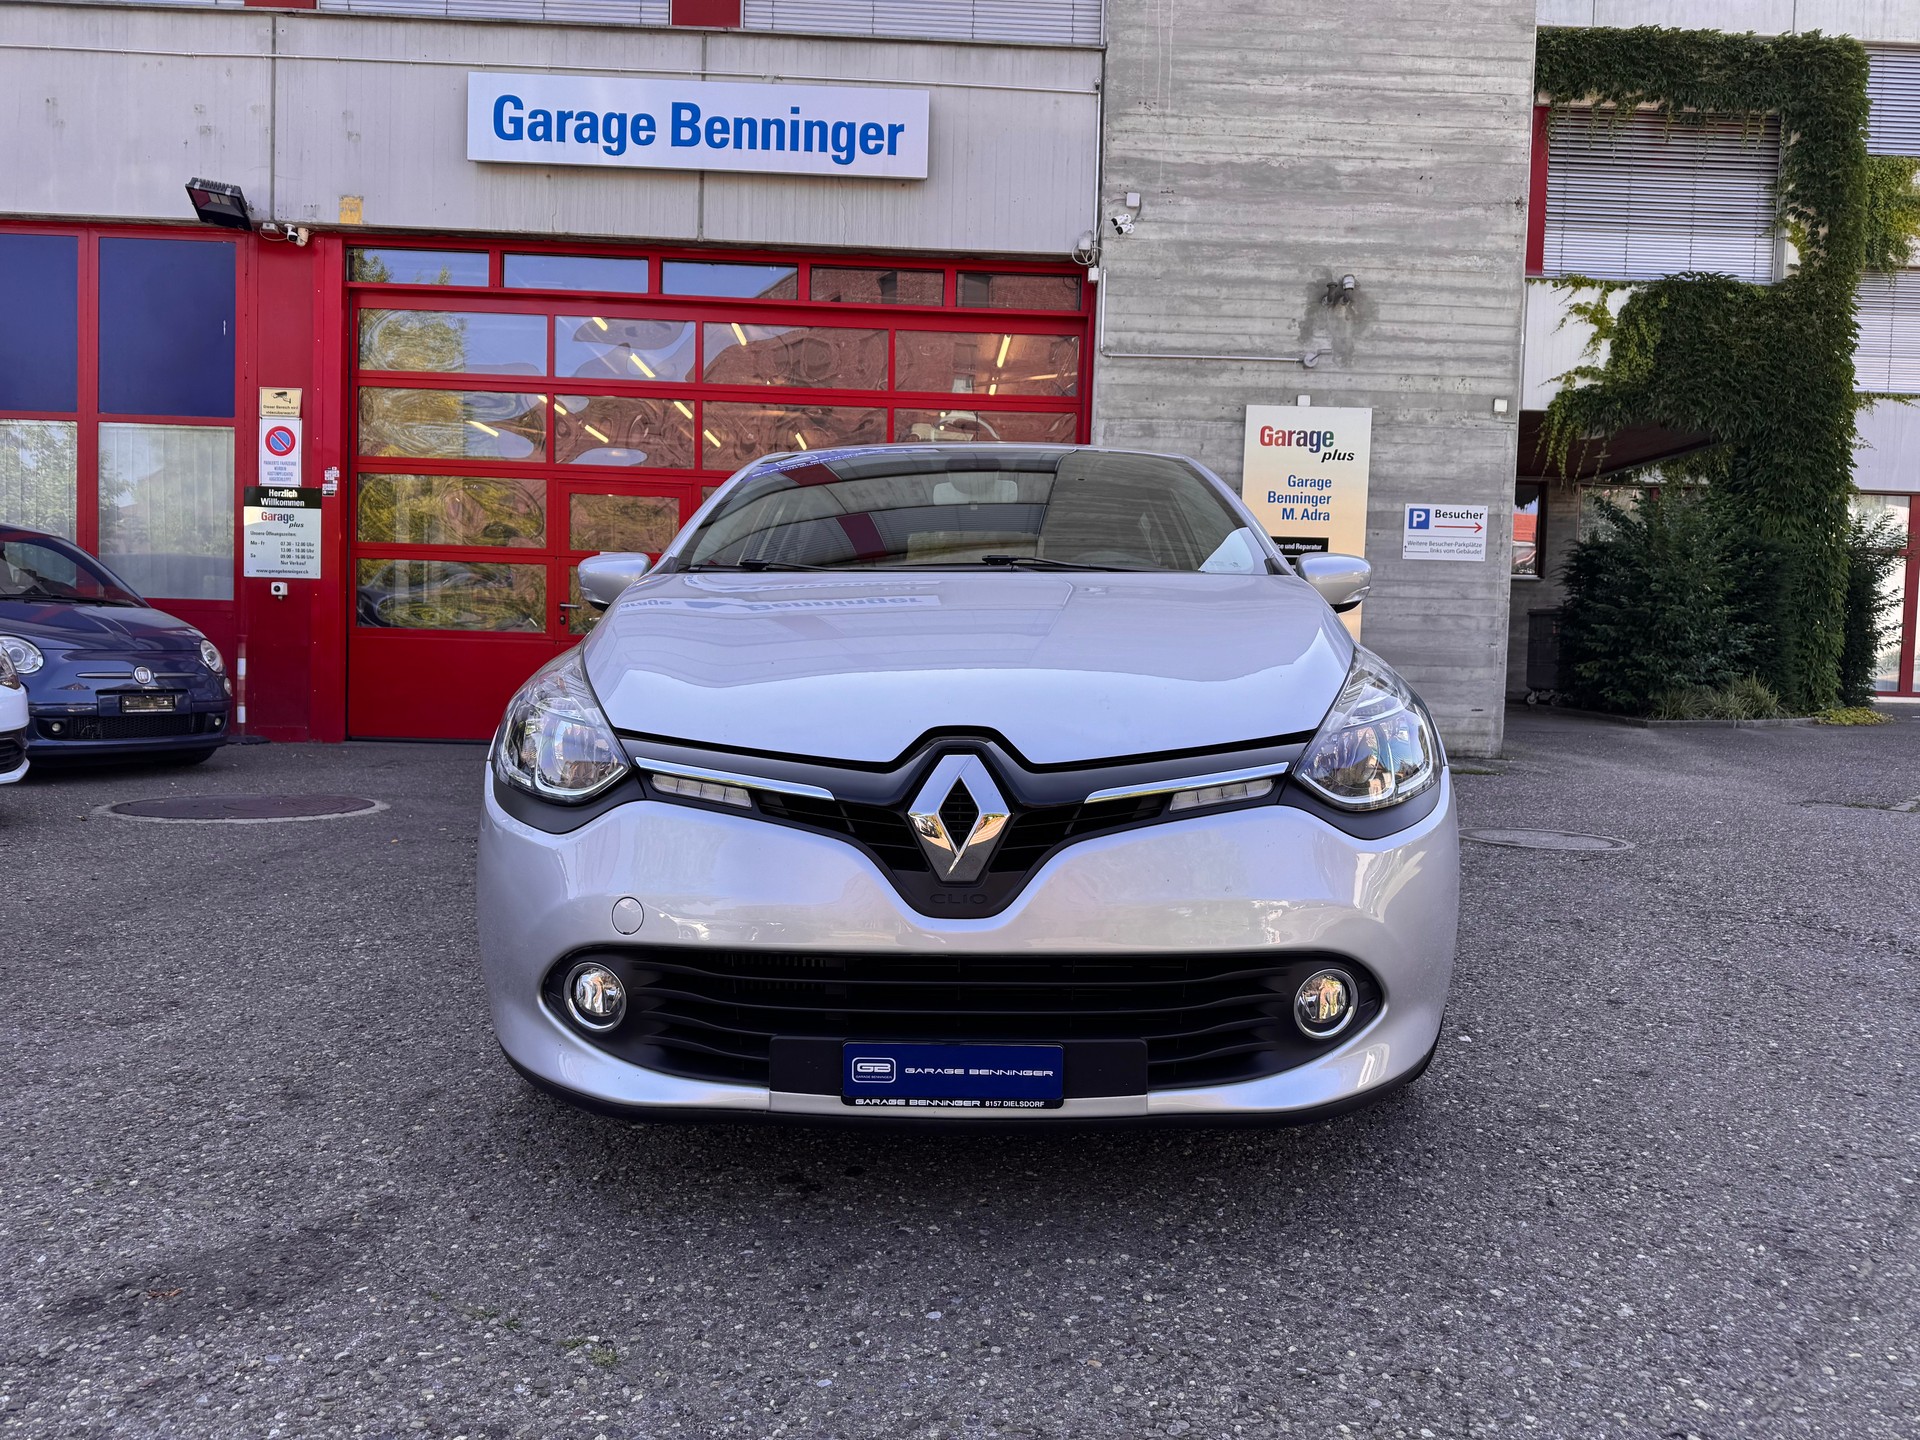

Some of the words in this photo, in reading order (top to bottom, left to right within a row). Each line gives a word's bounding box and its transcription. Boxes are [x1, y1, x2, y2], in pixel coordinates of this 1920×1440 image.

[493, 94, 656, 156] Garage
[670, 101, 905, 165] Benninger
[1259, 425, 1335, 453] Garage
[1321, 449, 1355, 463] plus
[1287, 474, 1332, 490] Garage
[268, 489, 298, 498] Herzlich
[1267, 490, 1332, 507] Benninger
[260, 497, 305, 507] Willkommen
[261, 511, 295, 524] Garage
[1281, 508, 1298, 521] M.
[1300, 508, 1330, 521] Adra
[1412, 510, 1426, 528] P
[1435, 509, 1484, 520] Besucher
[1295, 543, 1322, 551] Reparatur
[1429, 541, 1483, 549] Besucher-Parkplätze
[929, 893, 988, 905] CLIO
[857, 1063, 891, 1073] GB
[904, 1067, 965, 1075] GARAGE
[855, 1098, 905, 1106] GARAGE
[1003, 1100, 1045, 1108] DIELSDORF
